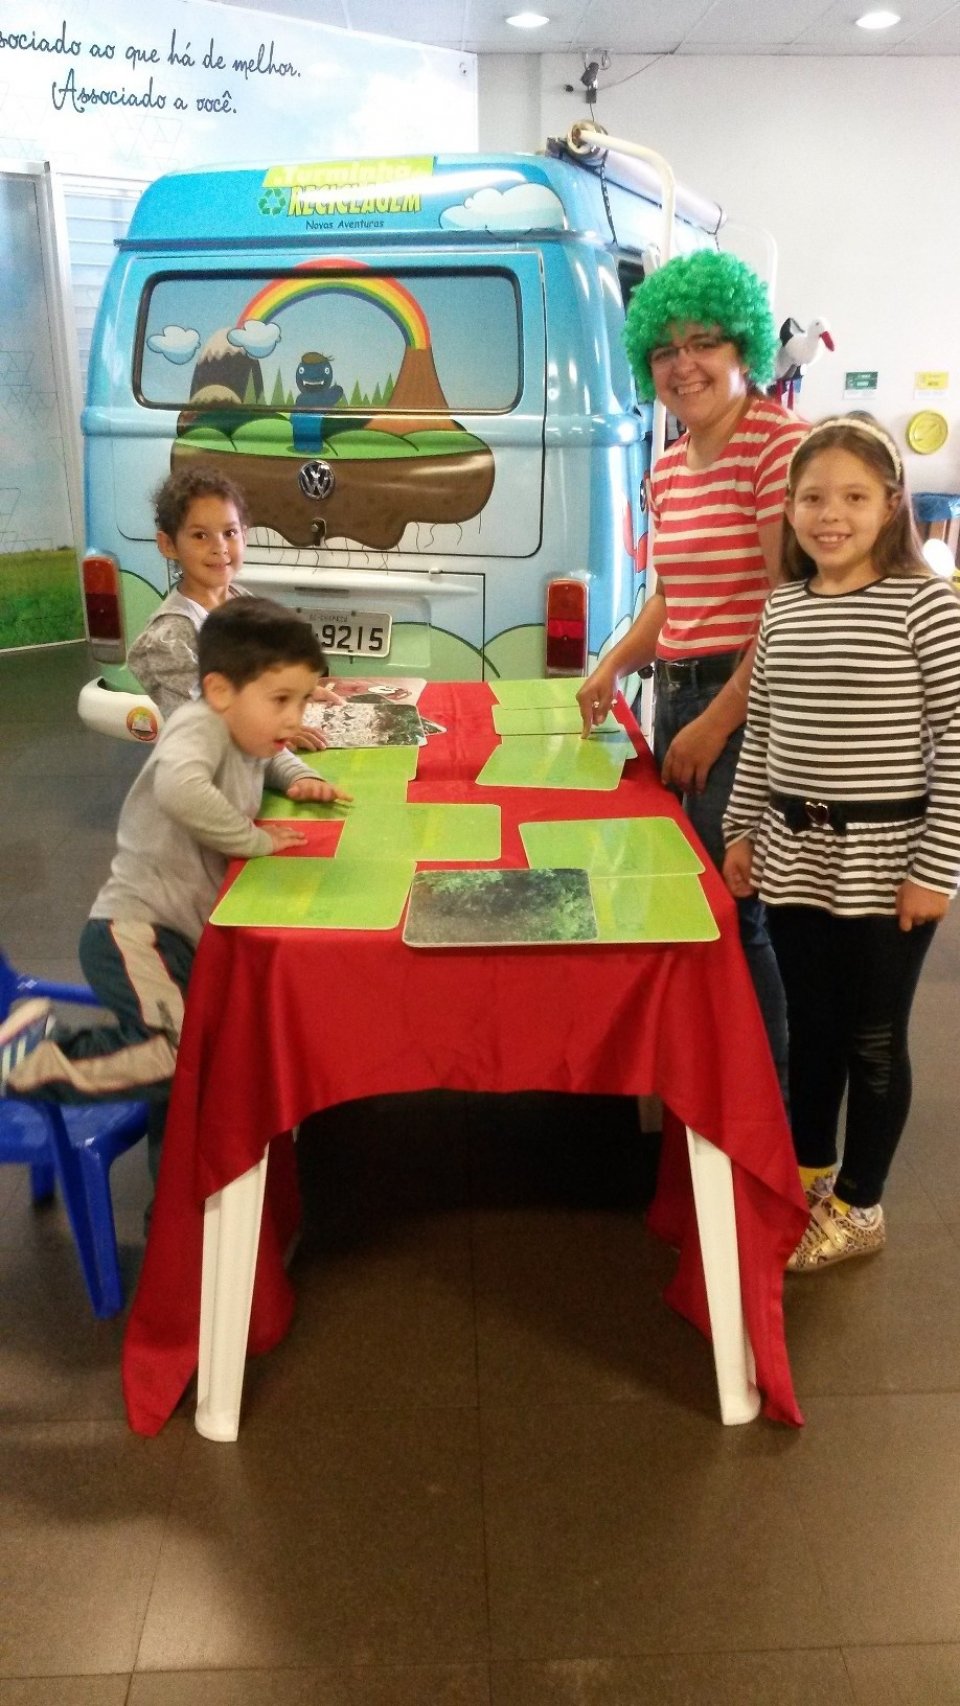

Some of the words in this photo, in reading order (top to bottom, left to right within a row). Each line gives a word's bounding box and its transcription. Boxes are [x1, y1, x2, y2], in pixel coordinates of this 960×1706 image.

[90, 44, 115, 59] ao
[125, 45, 161, 71] que
[167, 28, 195, 66] há
[202, 37, 226, 70] de
[232, 40, 301, 80] melhor.
[51, 67, 167, 114] Associado
[173, 97, 188, 111] a
[196, 90, 237, 114] você.
[287, 183, 422, 217] RECICLAGEM
[305, 219, 334, 231] Novas
[337, 219, 385, 230] Aventuras
